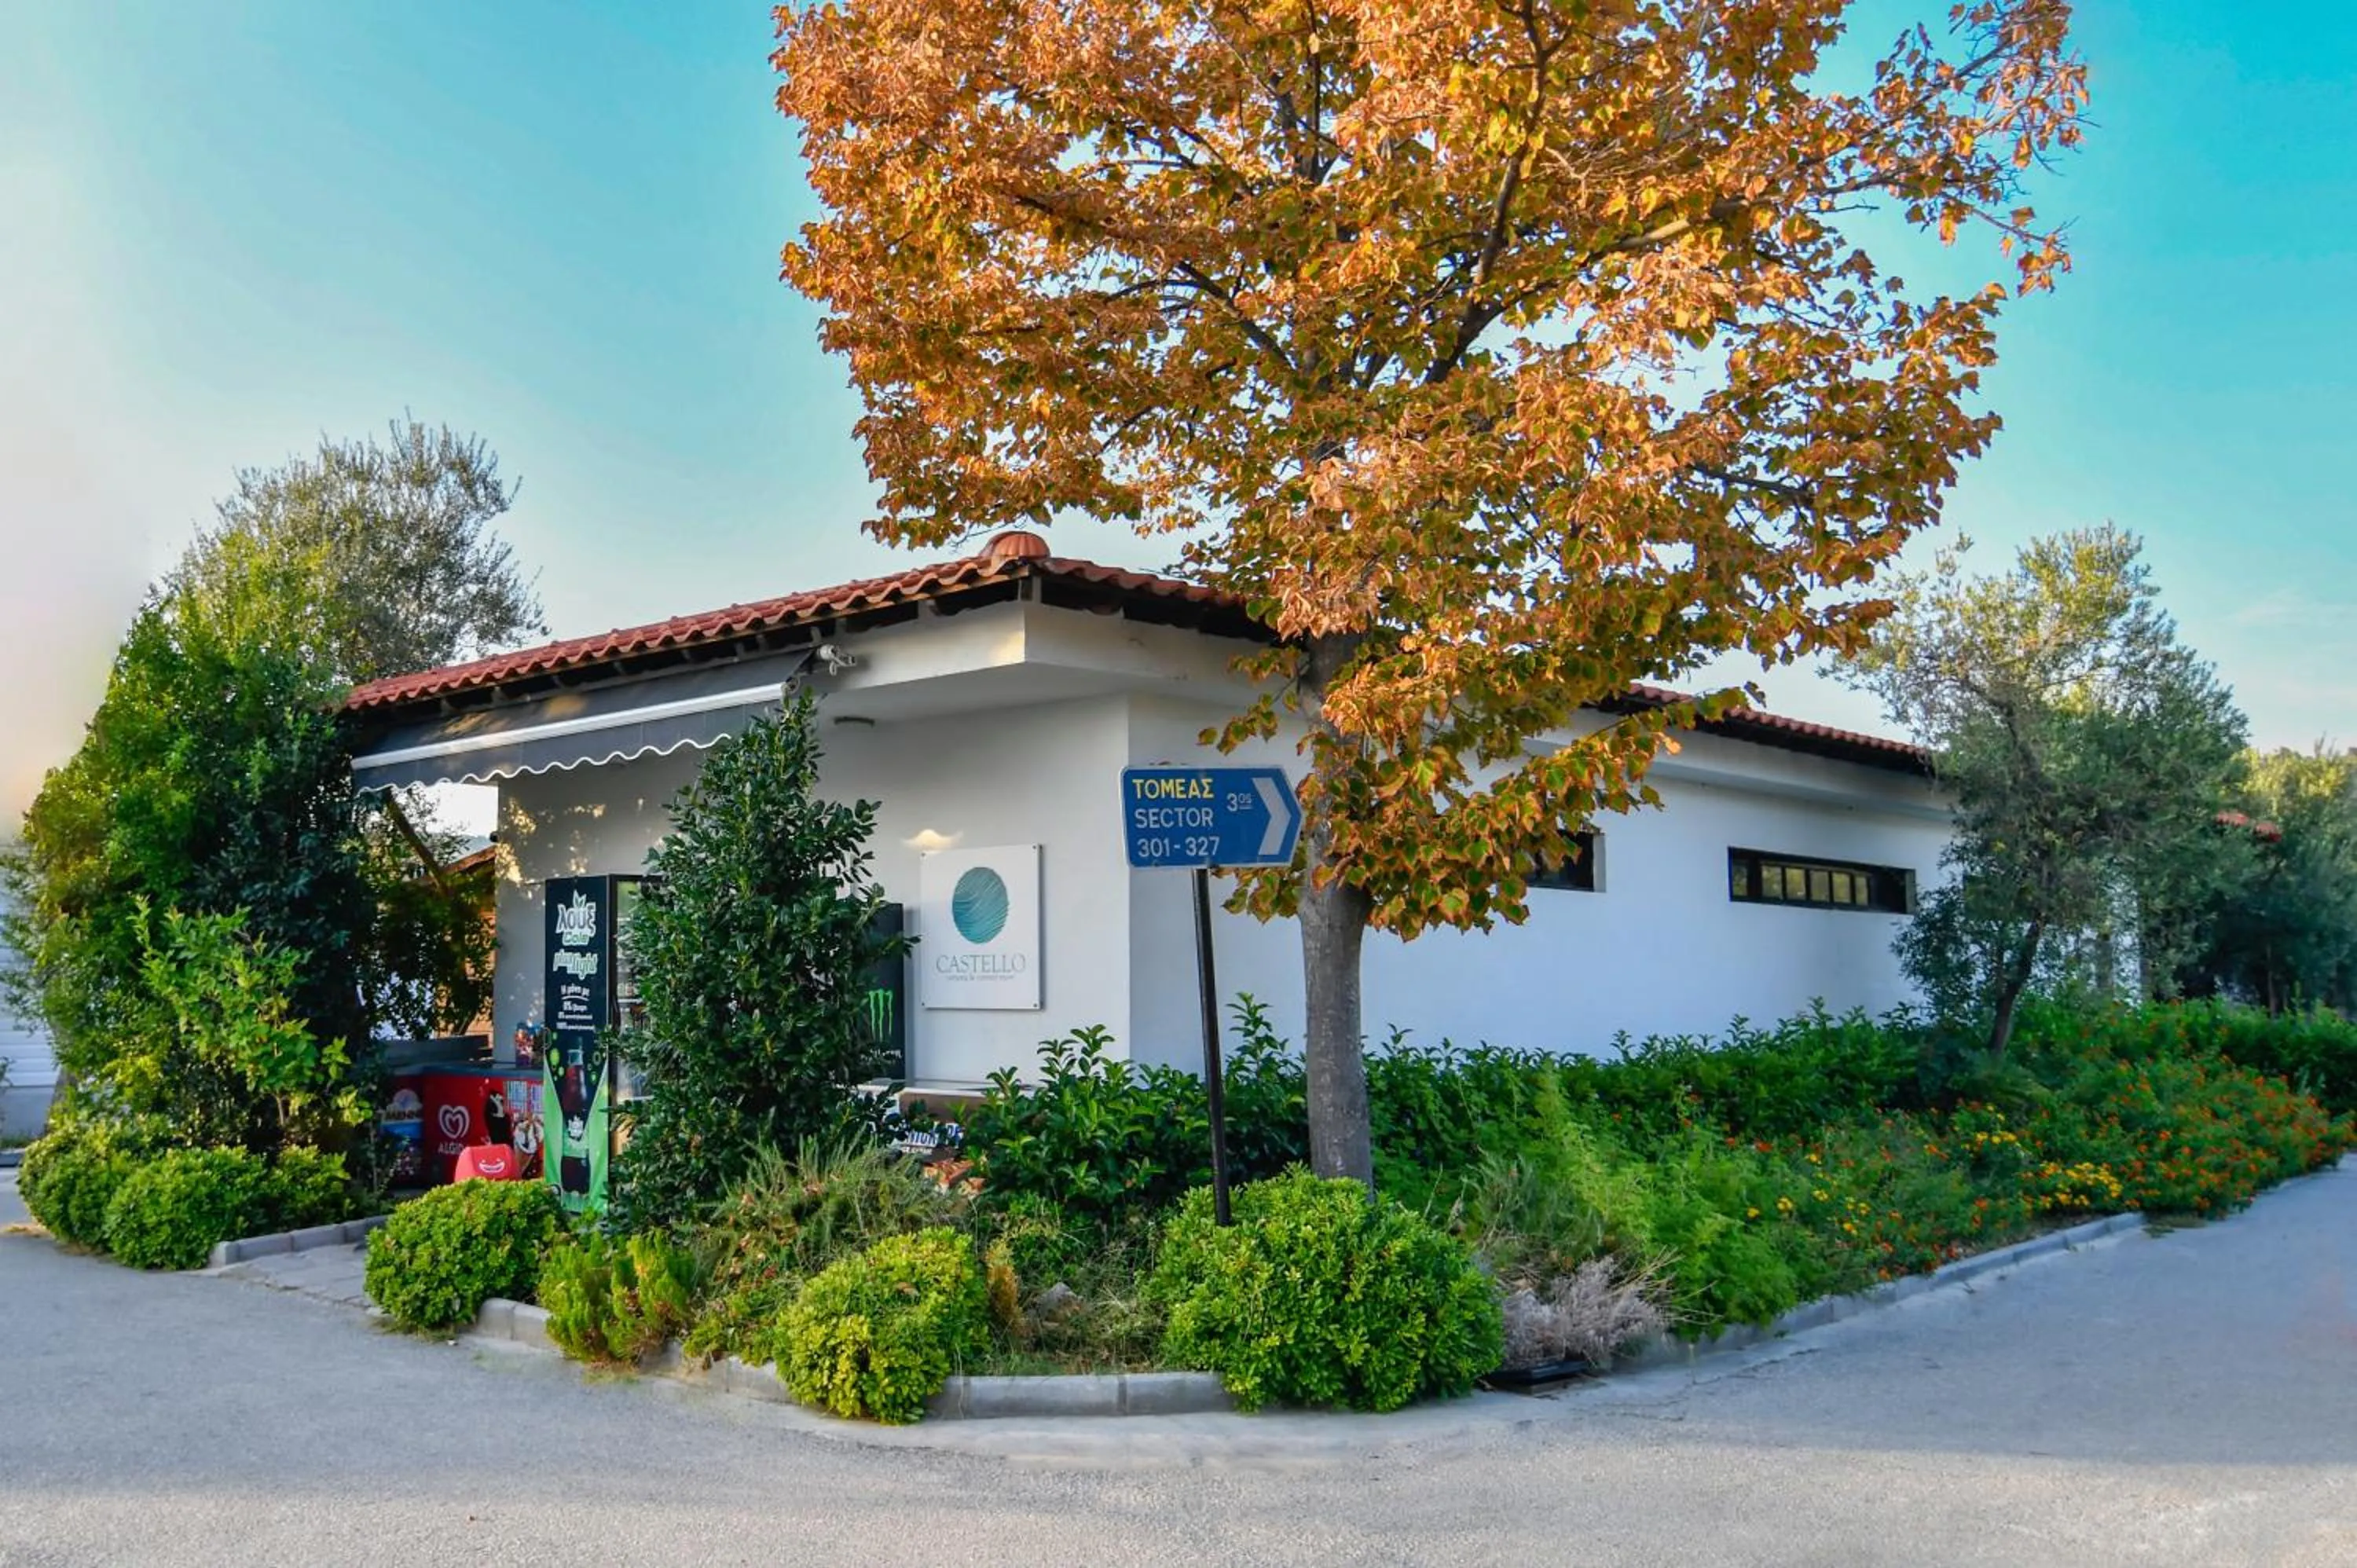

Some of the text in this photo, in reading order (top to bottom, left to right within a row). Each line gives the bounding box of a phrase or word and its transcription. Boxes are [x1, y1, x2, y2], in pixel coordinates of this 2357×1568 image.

[1132, 778, 1214, 800] ΤΟΜΕΑΣ
[1135, 807, 1213, 828] SECTOR
[936, 953, 1025, 973] CASTELLO
[438, 1142, 465, 1155] ALGID
